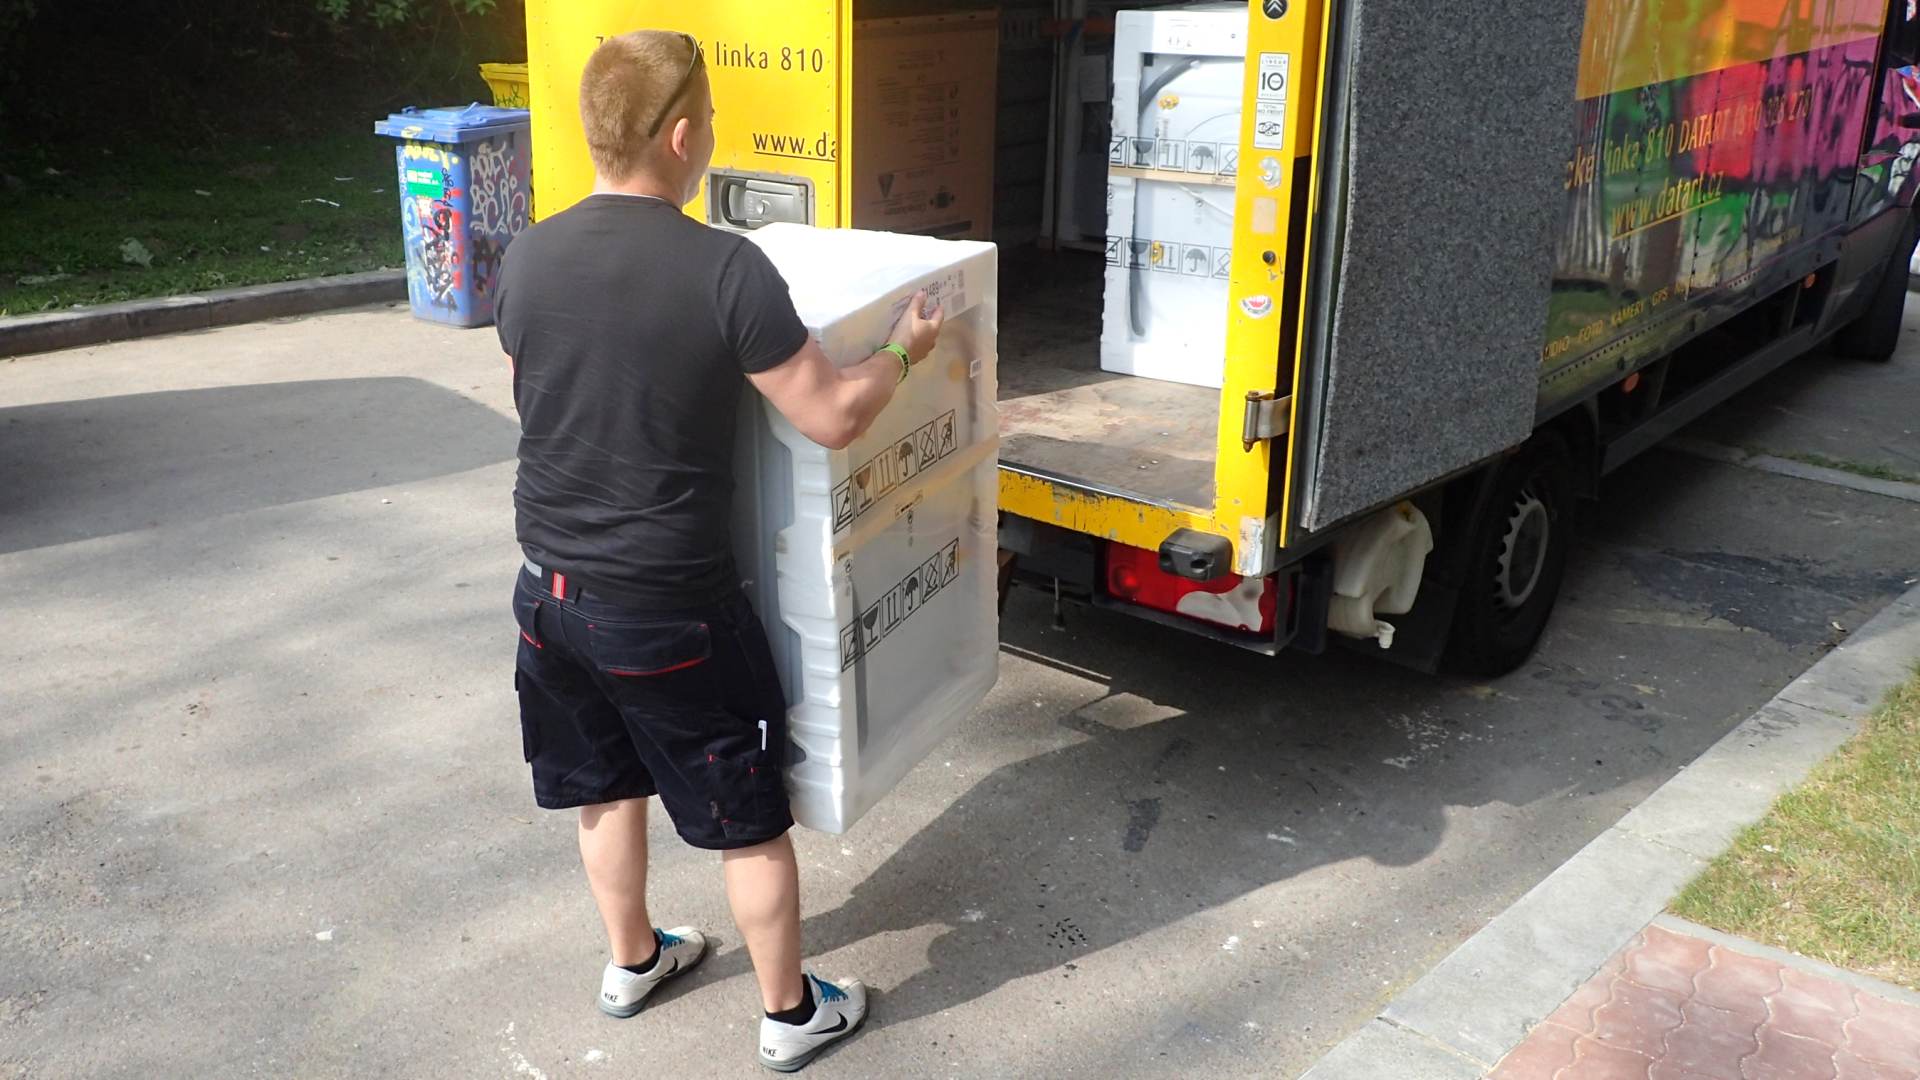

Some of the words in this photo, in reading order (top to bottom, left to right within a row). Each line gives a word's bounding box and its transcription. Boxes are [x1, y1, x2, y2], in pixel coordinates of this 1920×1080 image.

[716, 42, 768, 70] linka
[780, 47, 823, 73] 810
[1645, 124, 1674, 164] 810
[1678, 108, 1731, 154] DATART
[1612, 171, 1723, 239] www.datart.cz
[604, 991, 620, 1004] NIKE
[762, 1045, 778, 1058] NIKE
